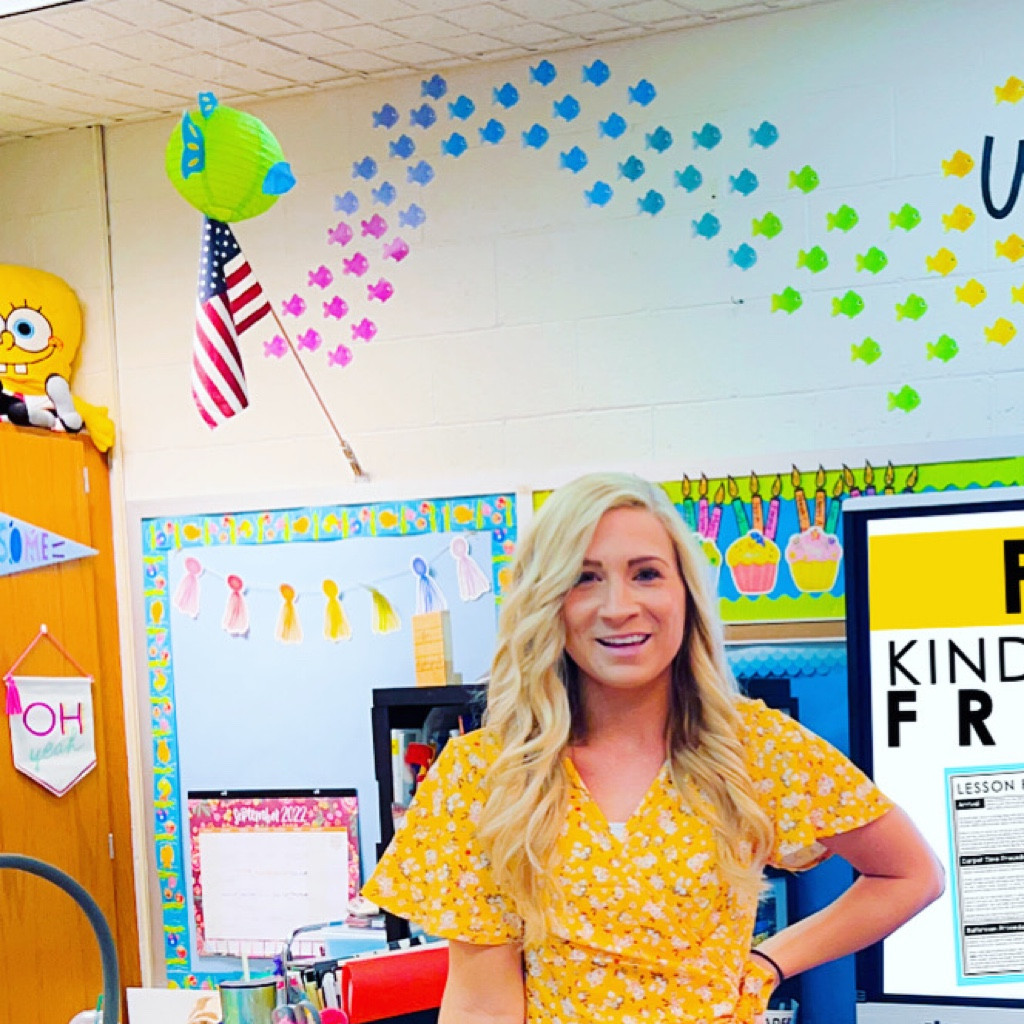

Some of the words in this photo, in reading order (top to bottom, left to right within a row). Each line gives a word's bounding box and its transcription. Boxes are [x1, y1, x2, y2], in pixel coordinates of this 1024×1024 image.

[23, 702, 83, 736] OH
[29, 729, 84, 772] yeah
[957, 779, 1015, 795] LESSON
[233, 806, 280, 825] September
[281, 806, 308, 824] 2022
